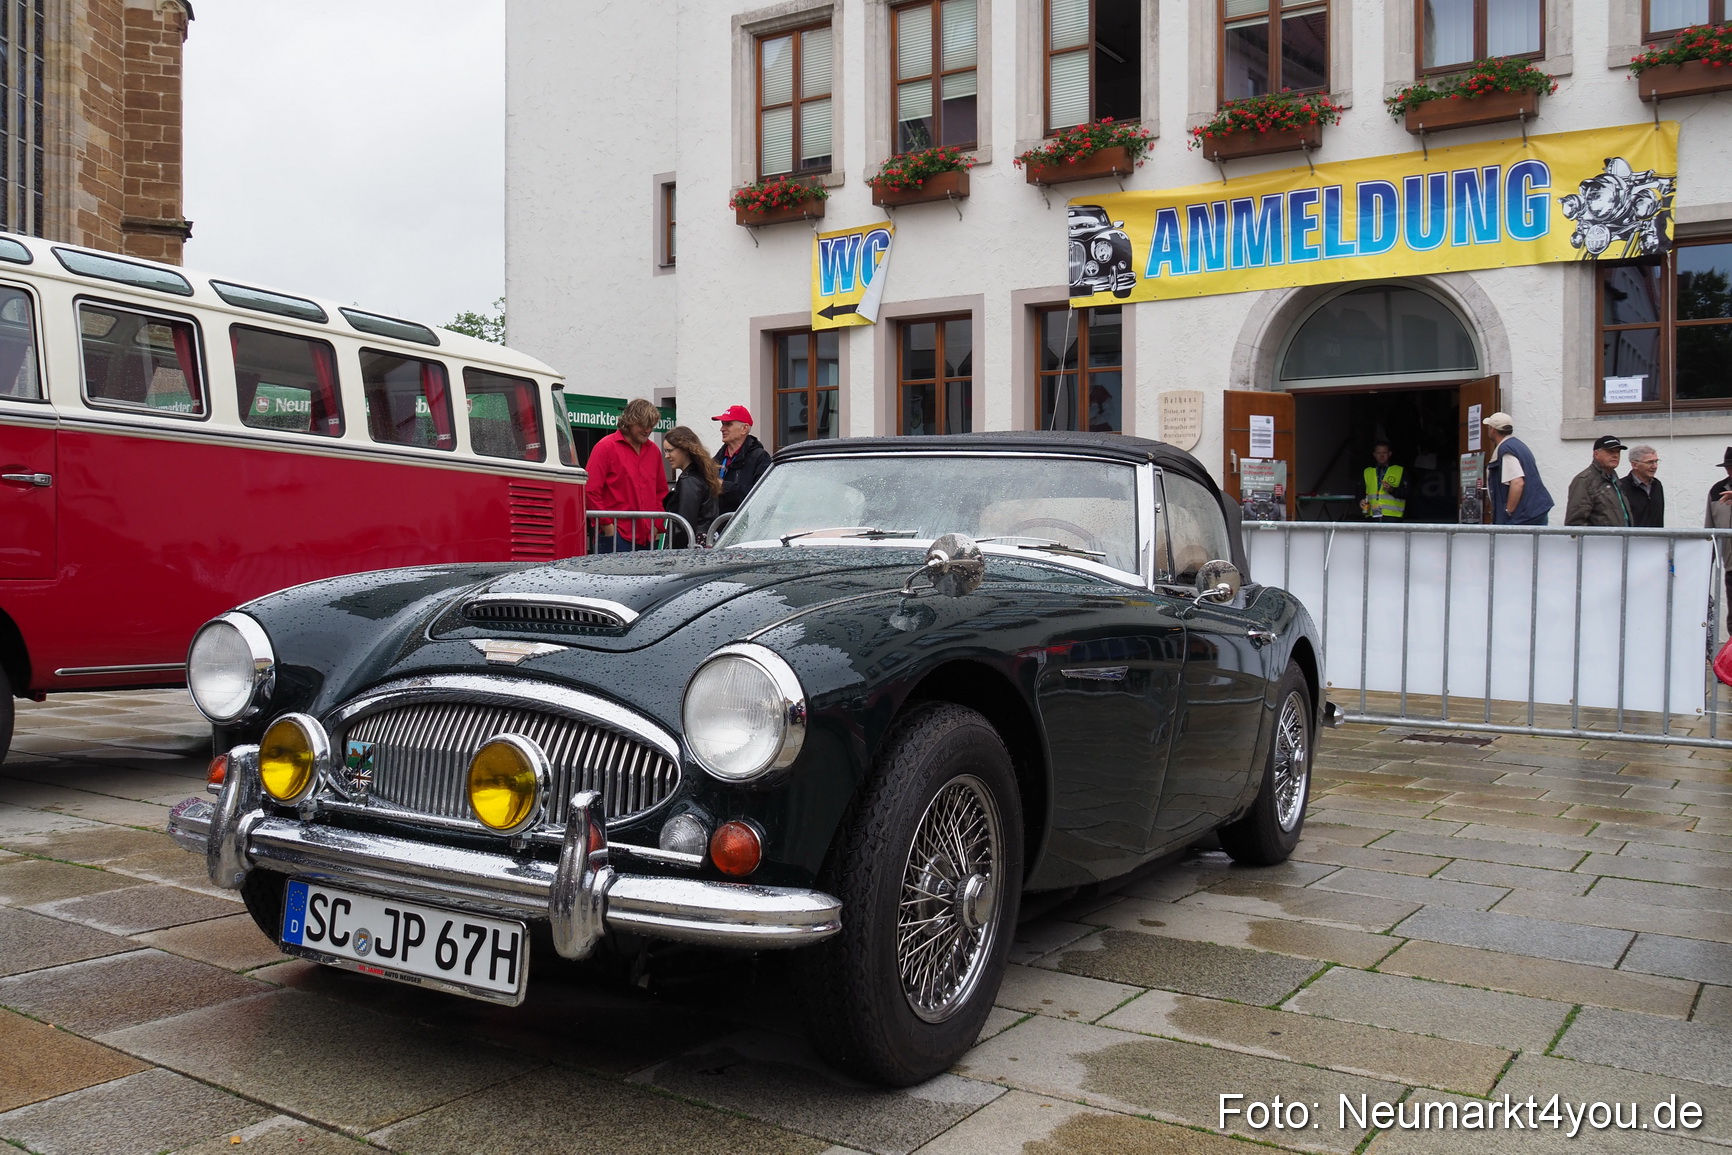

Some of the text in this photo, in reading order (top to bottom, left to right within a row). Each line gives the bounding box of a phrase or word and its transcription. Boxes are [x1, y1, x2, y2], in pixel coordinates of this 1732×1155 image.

[1144, 159, 1551, 279] ANMELDUNG
[818, 228, 892, 296] WC
[567, 411, 620, 426] eumarkter
[290, 919, 299, 933] D
[305, 892, 520, 984] SC JP 67H
[384, 970, 399, 979] AUTO
